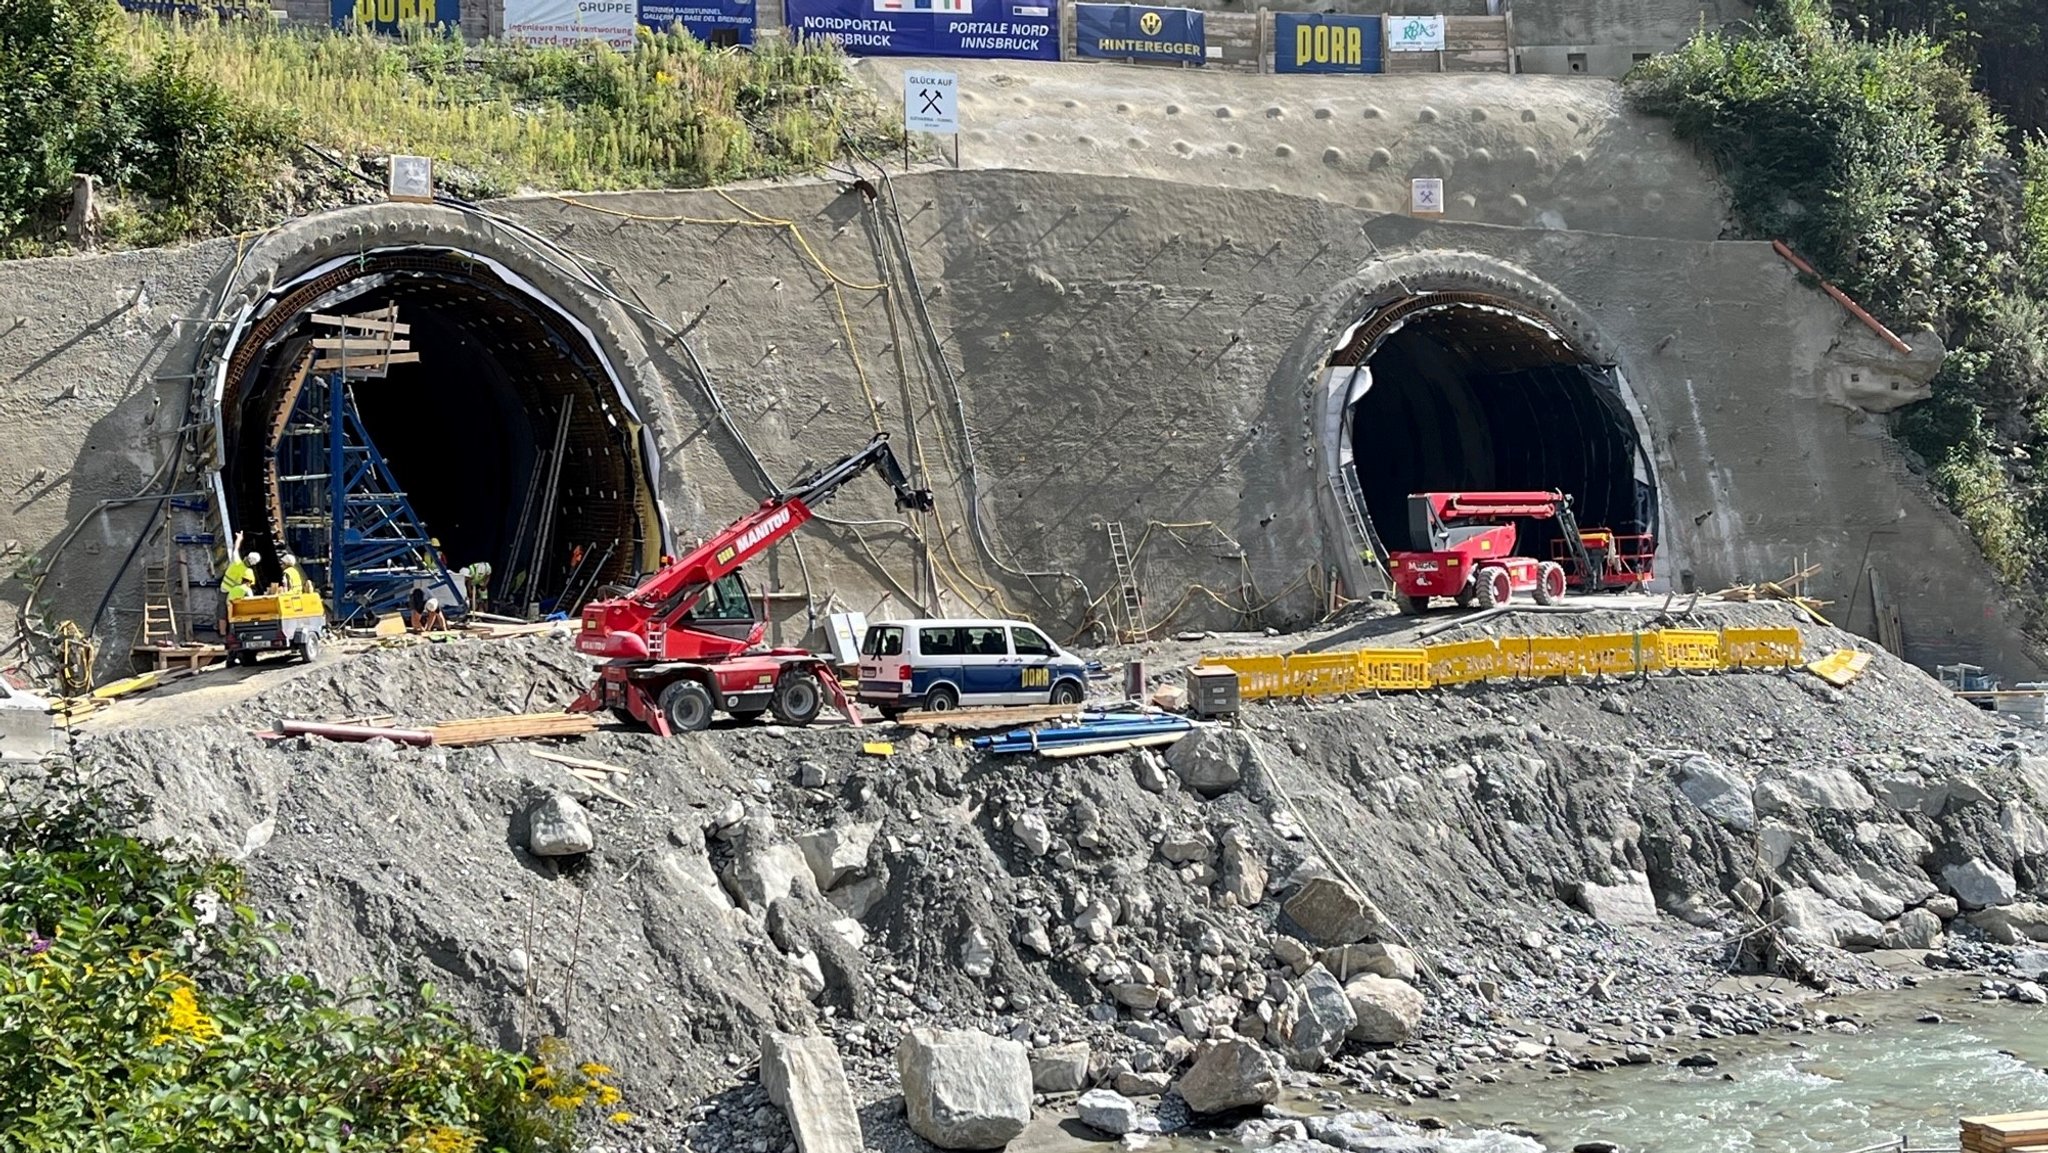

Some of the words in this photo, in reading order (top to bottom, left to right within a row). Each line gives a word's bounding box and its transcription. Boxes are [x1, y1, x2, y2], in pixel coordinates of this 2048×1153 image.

[578, 2, 632, 13] GRUPPE
[643, 6, 675, 14] BRENNER
[675, 7, 722, 15] BASISTUNNEL
[684, 14, 702, 22] BASE
[717, 16, 753, 24] BRENNERO
[804, 16, 896, 32] NORDPORTAL
[555, 23, 571, 32] mit
[571, 24, 633, 36] Verantwortung
[949, 22, 1008, 34] PORTALE
[1011, 24, 1049, 36] NORD
[961, 37, 1039, 50] INNSBRUCK
[1099, 38, 1201, 56] HINTEREGGER
[1296, 24, 1361, 66] PORR
[910, 76, 936, 85] GLÜCK
[736, 506, 791, 553] MANITOU
